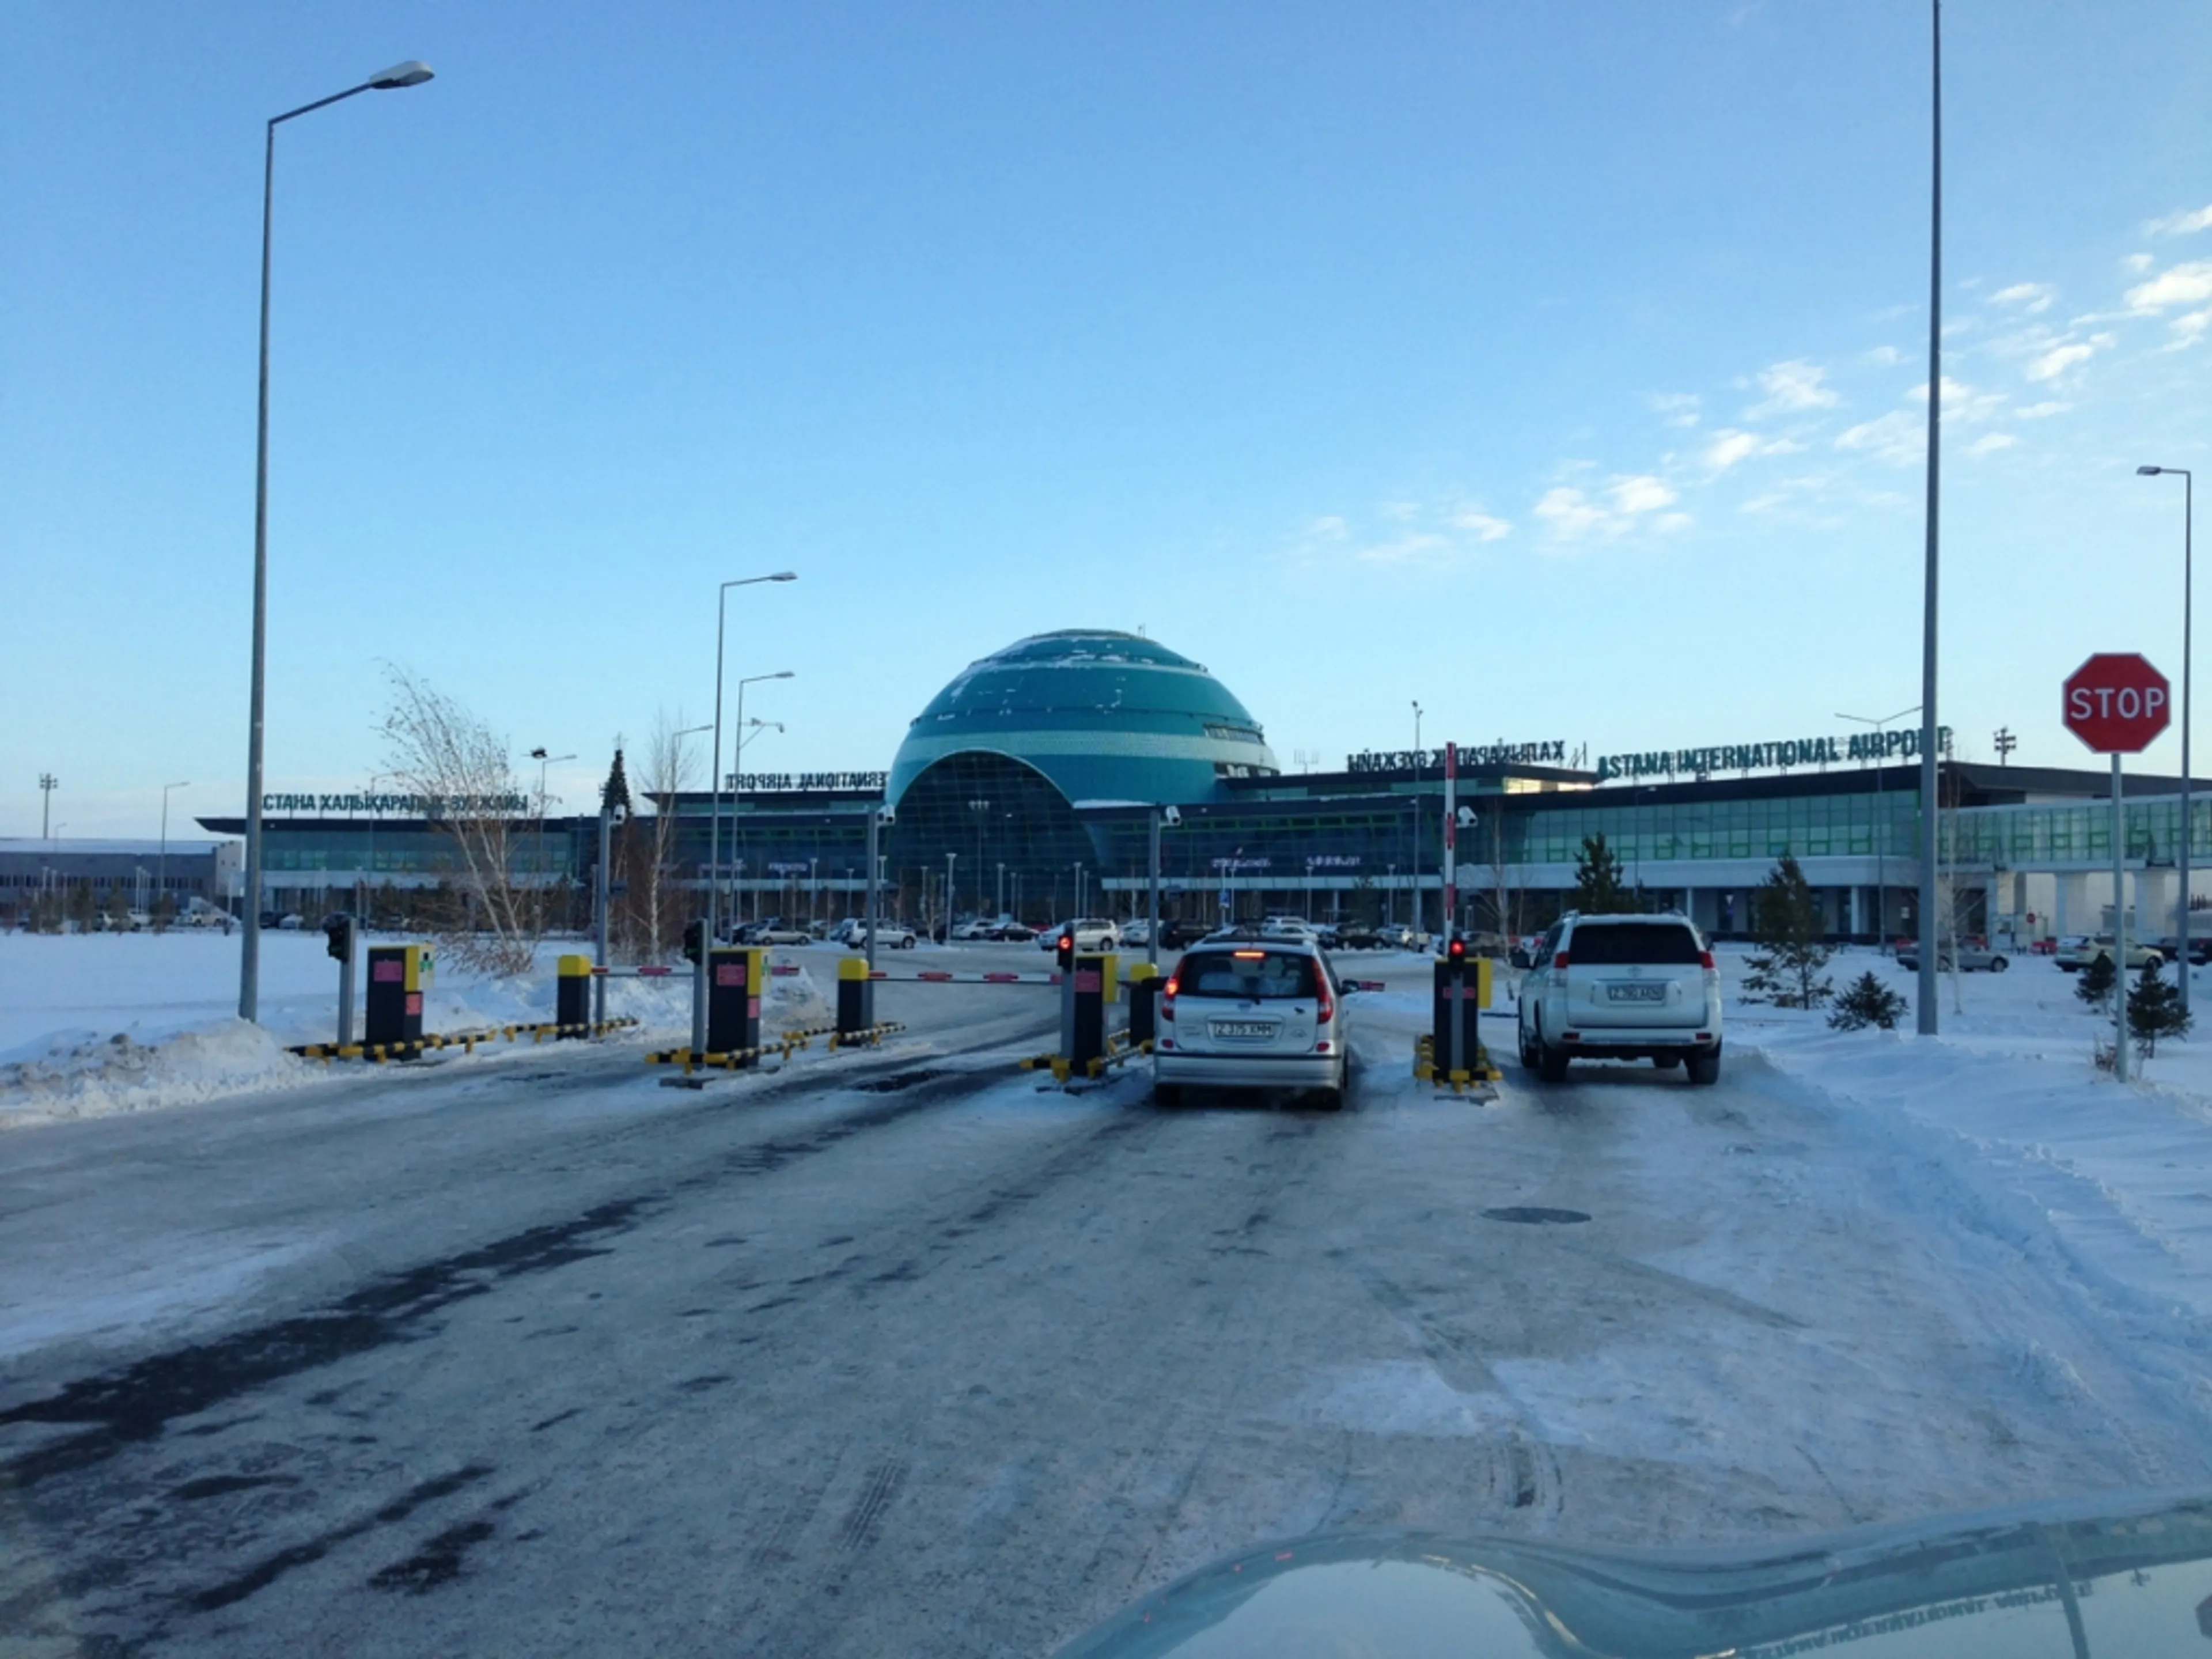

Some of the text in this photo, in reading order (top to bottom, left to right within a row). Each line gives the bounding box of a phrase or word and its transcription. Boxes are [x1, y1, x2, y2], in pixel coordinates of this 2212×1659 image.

[2069, 687, 2165, 720] STOP
[1598, 726, 1953, 779] ASTANA INTERNATIONAL AIRPOT
[263, 793, 316, 811] СТАНА
